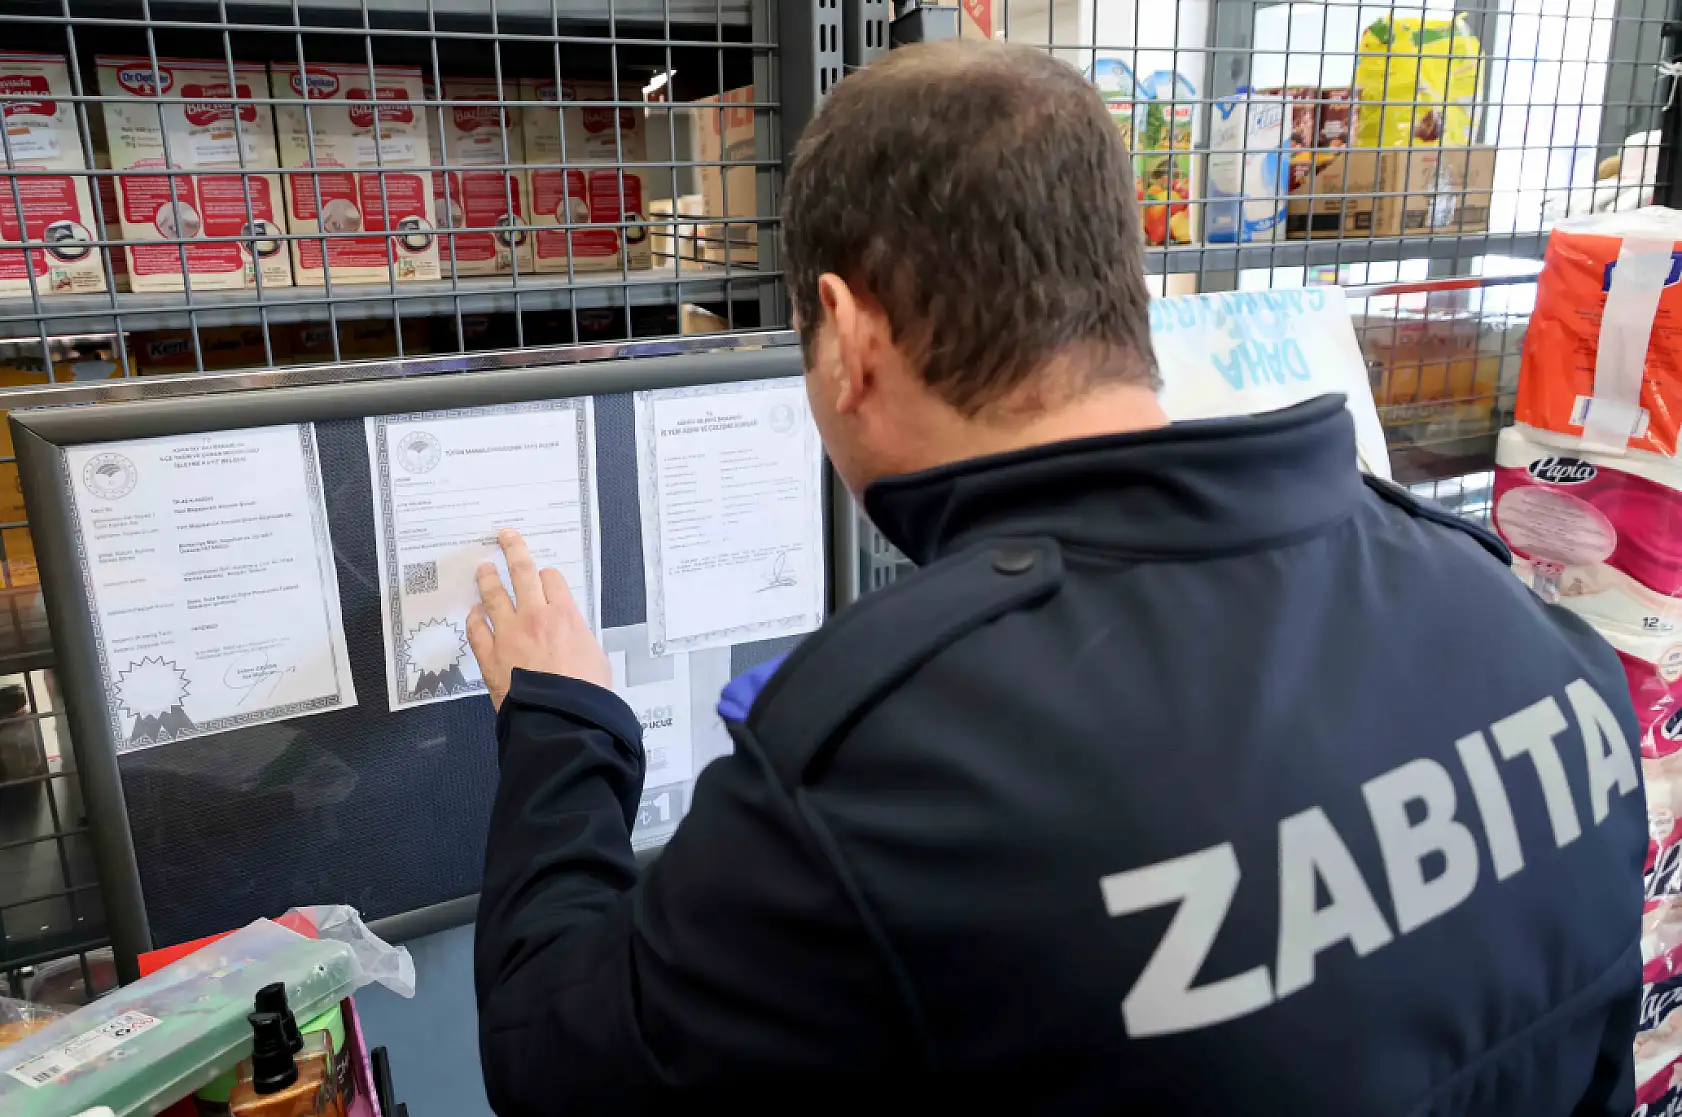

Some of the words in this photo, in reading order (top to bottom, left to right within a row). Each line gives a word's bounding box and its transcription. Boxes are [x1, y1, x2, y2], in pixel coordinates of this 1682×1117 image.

[1533, 455, 1592, 483] Papia
[1643, 617, 1660, 628] 12
[1100, 680, 1638, 1039] ZABITA
